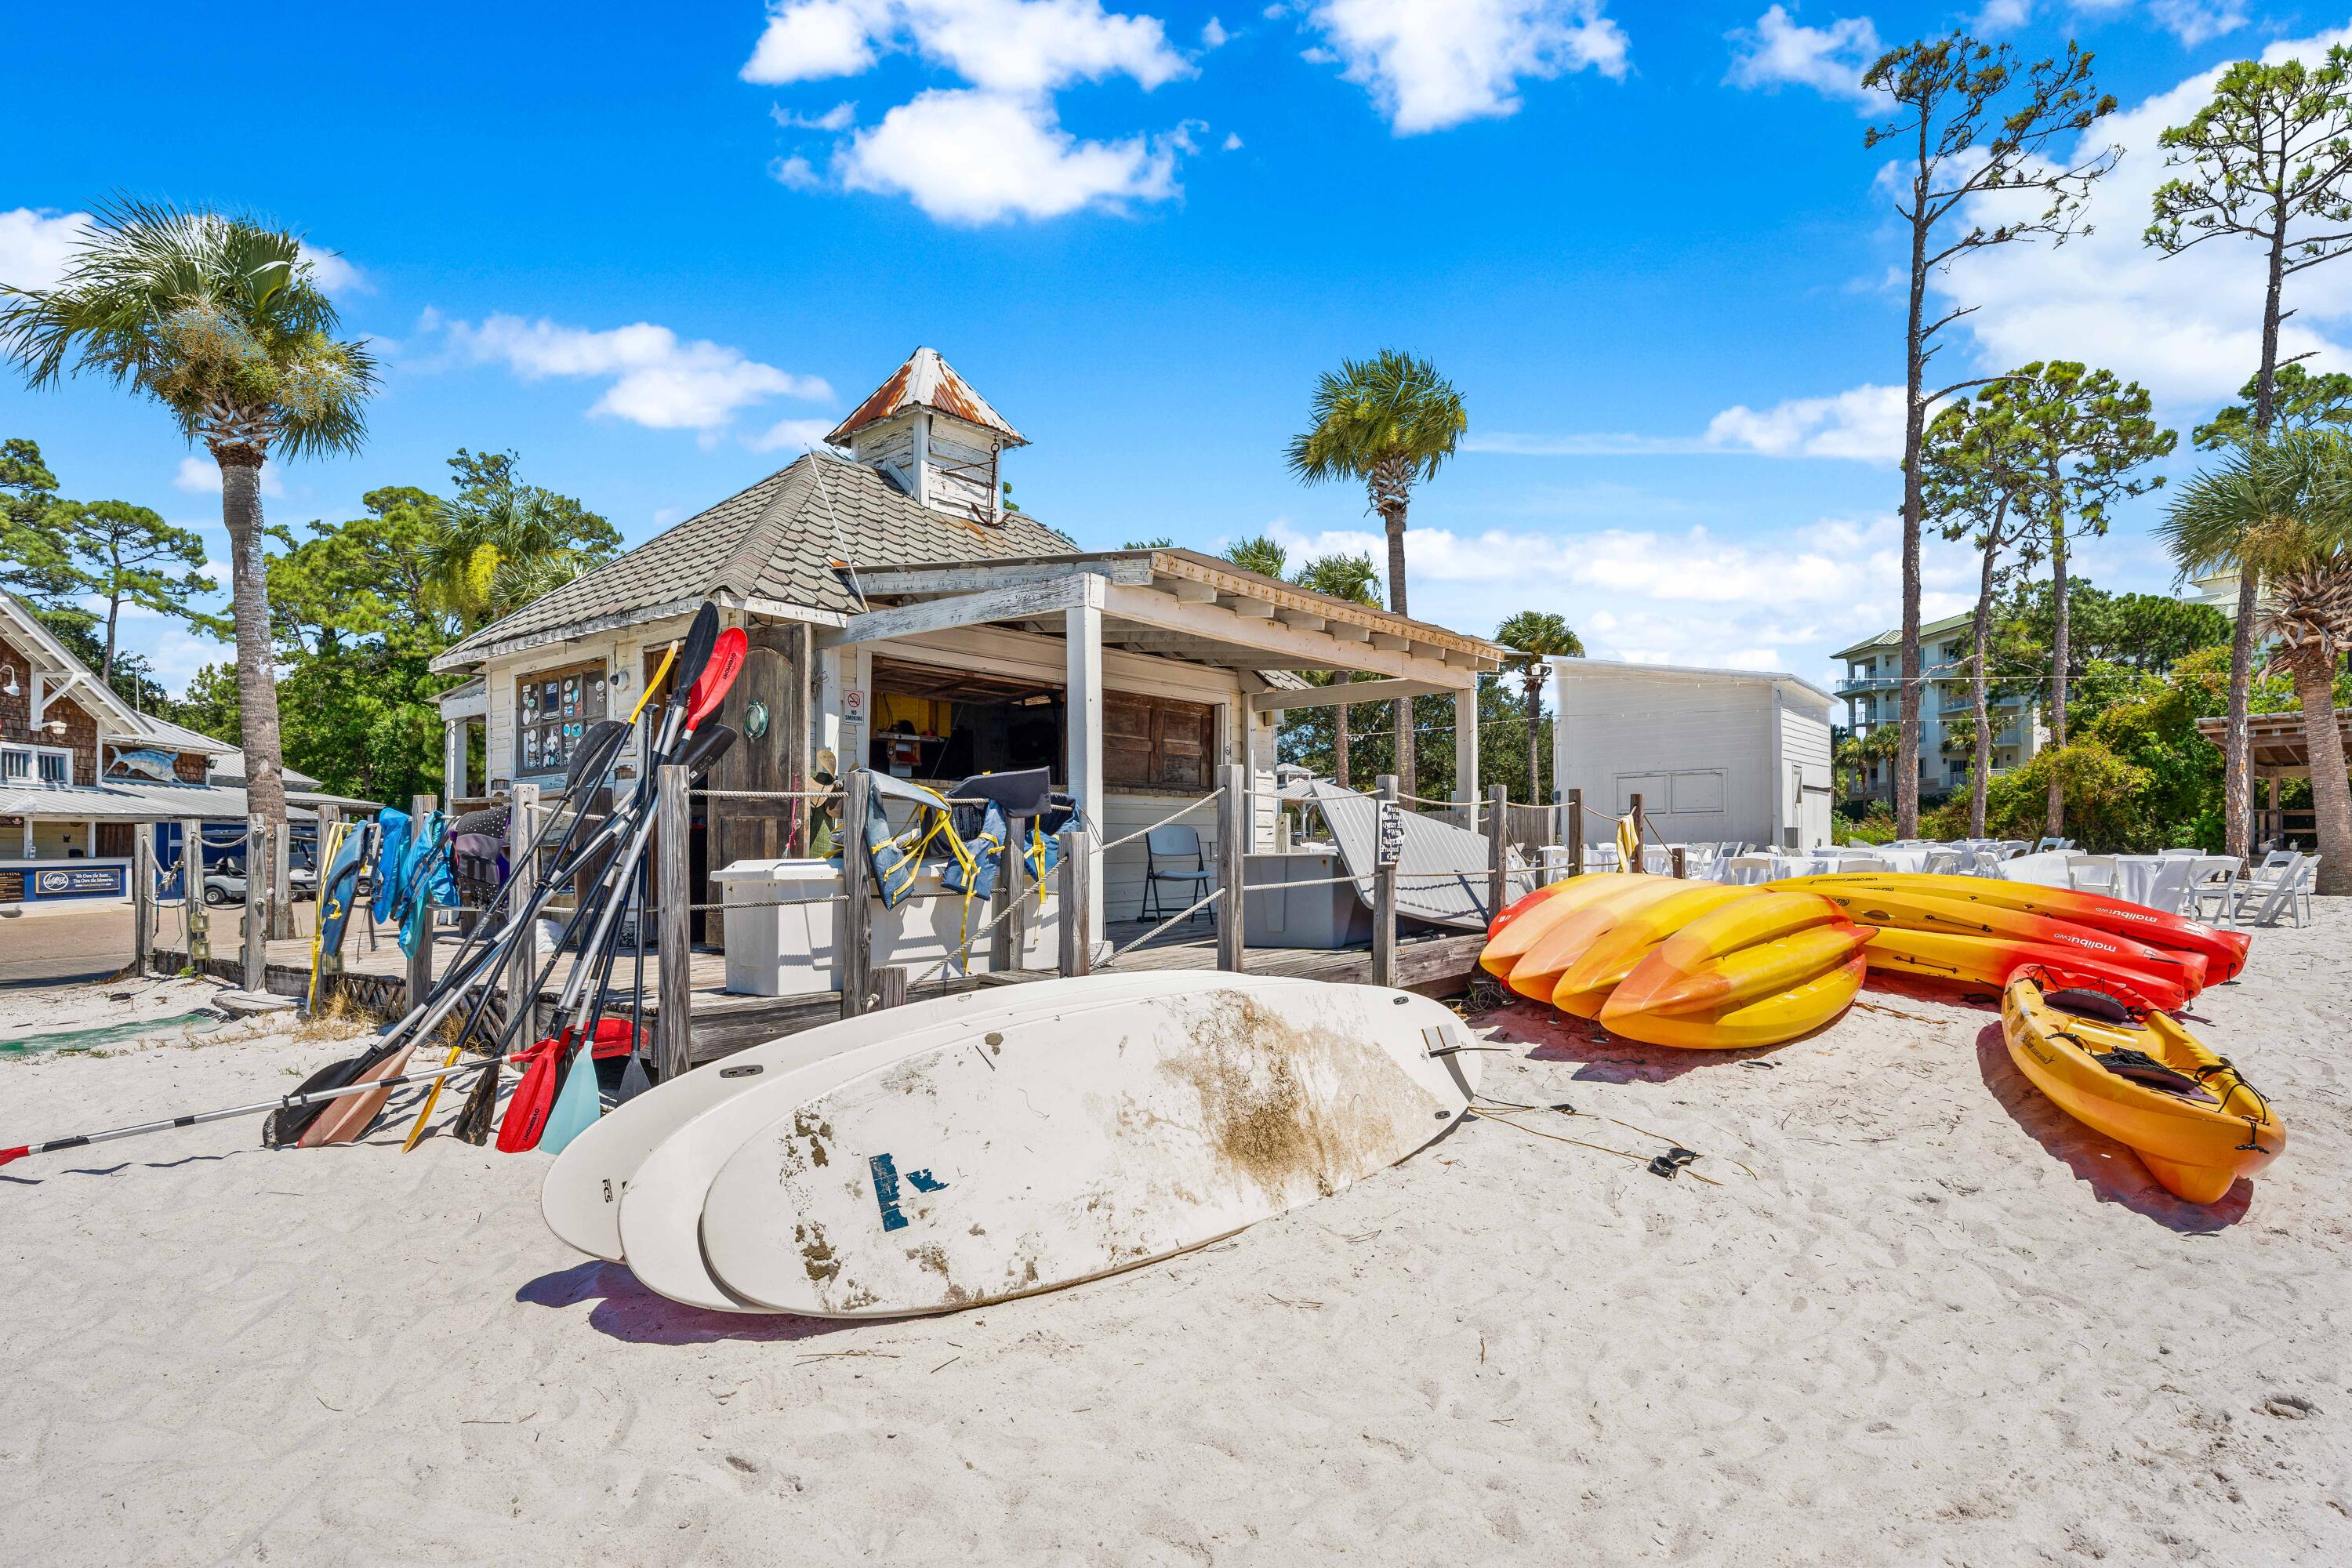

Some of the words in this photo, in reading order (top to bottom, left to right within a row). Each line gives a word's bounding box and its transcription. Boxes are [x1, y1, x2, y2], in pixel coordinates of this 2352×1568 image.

[722, 652, 736, 680] OVERMONT
[524, 1108, 540, 1142] OVERMONT
[602, 1179, 612, 1203] FCS
